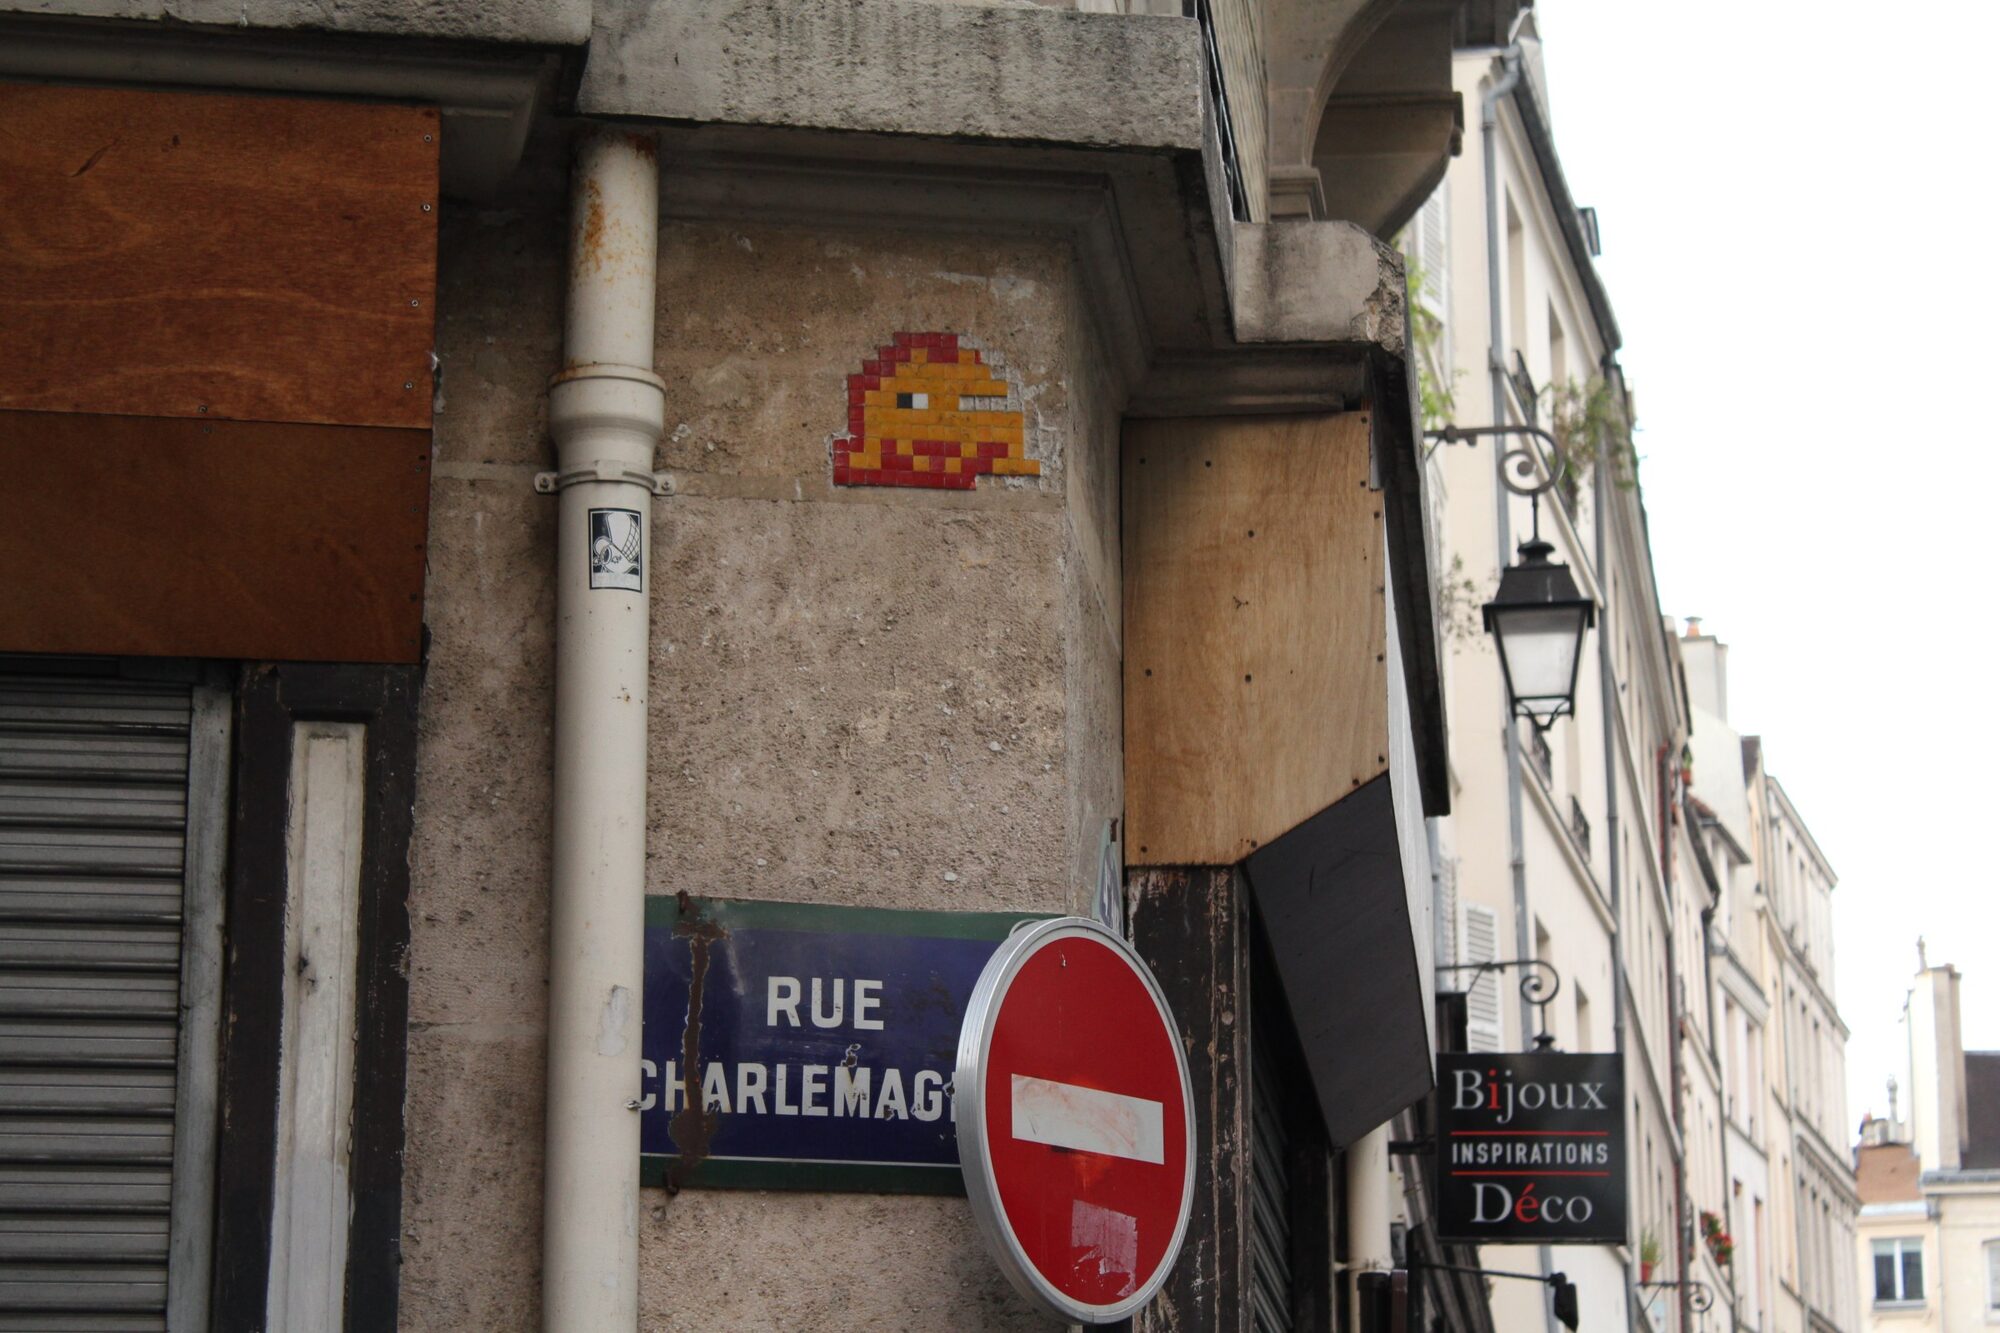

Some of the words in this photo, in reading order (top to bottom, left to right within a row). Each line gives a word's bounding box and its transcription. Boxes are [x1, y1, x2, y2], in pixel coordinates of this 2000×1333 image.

[766, 976, 884, 1030] RUE
[640, 1059, 956, 1122] CHARLEMAG
[1452, 1069, 1608, 1124] Bijoux
[1452, 1143, 1608, 1164] INSPIRATIONS
[1470, 1183, 1593, 1223] Déco
